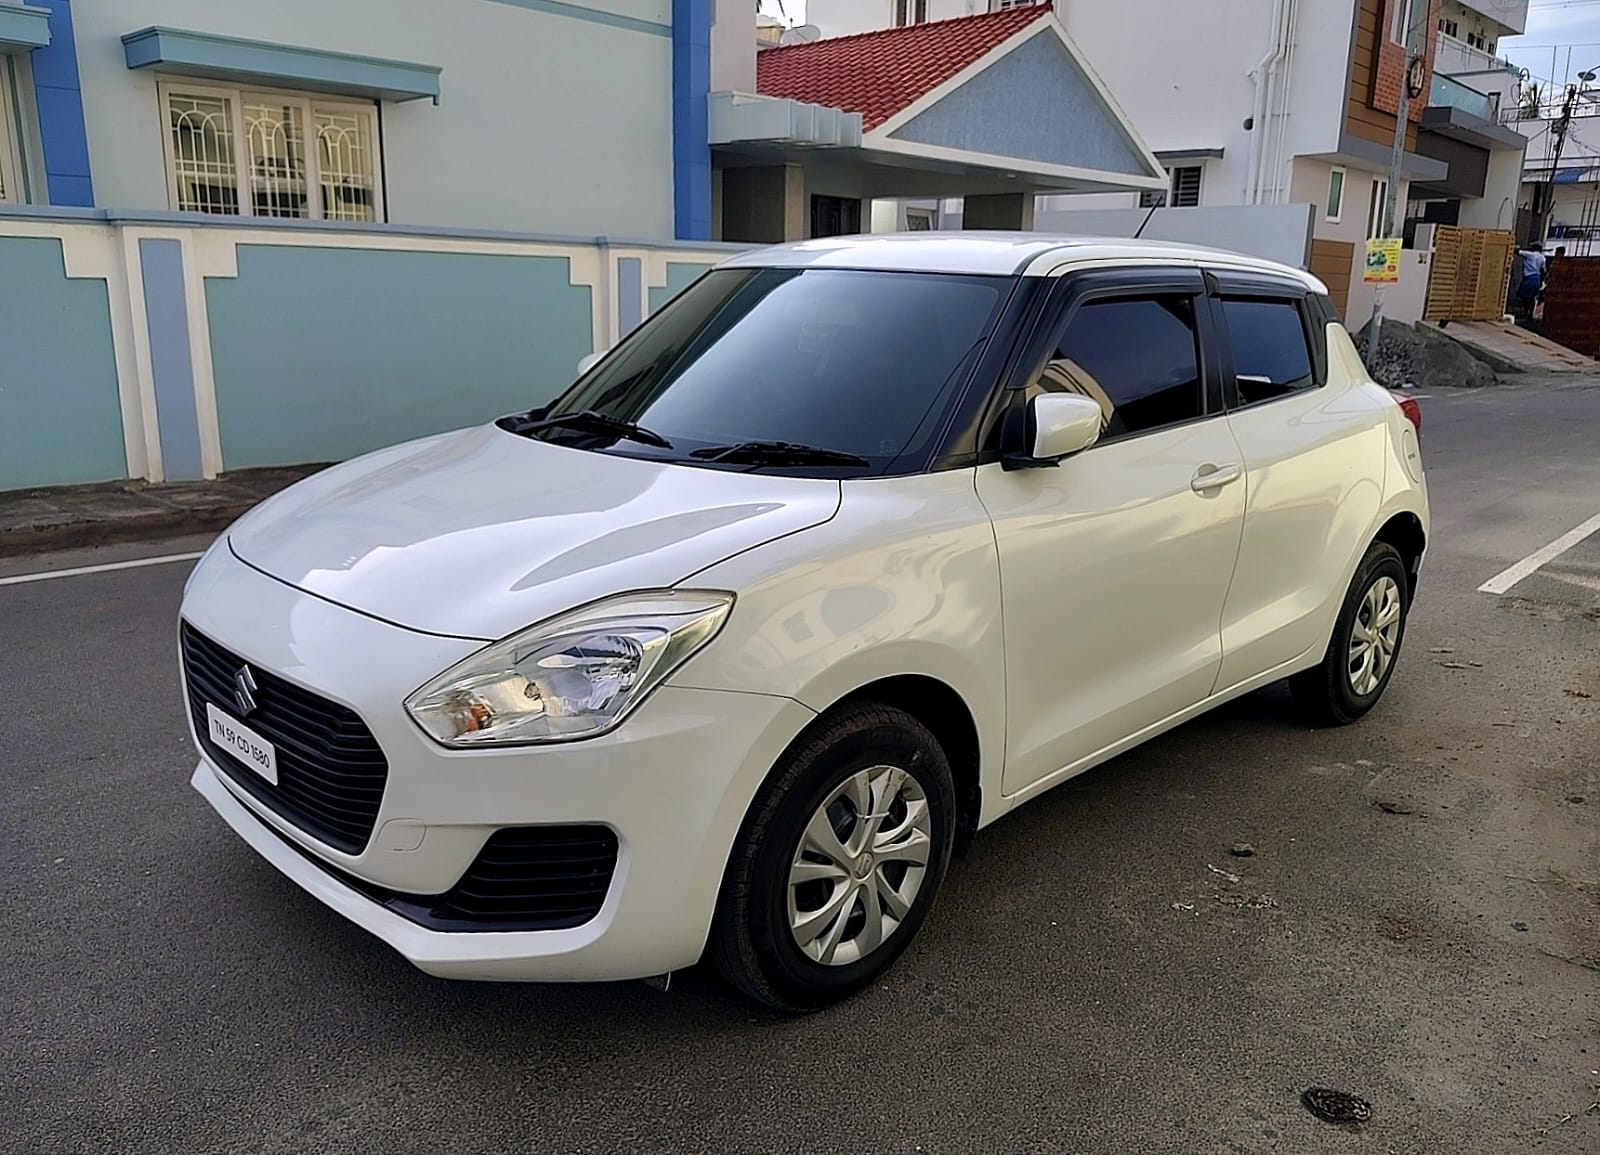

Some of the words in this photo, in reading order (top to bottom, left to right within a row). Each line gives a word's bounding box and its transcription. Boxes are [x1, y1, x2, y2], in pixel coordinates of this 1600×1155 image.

[214, 719, 225, 738] TN
[226, 727, 236, 744] 59
[237, 735, 250, 754] CD
[250, 744, 270, 768] 1580
